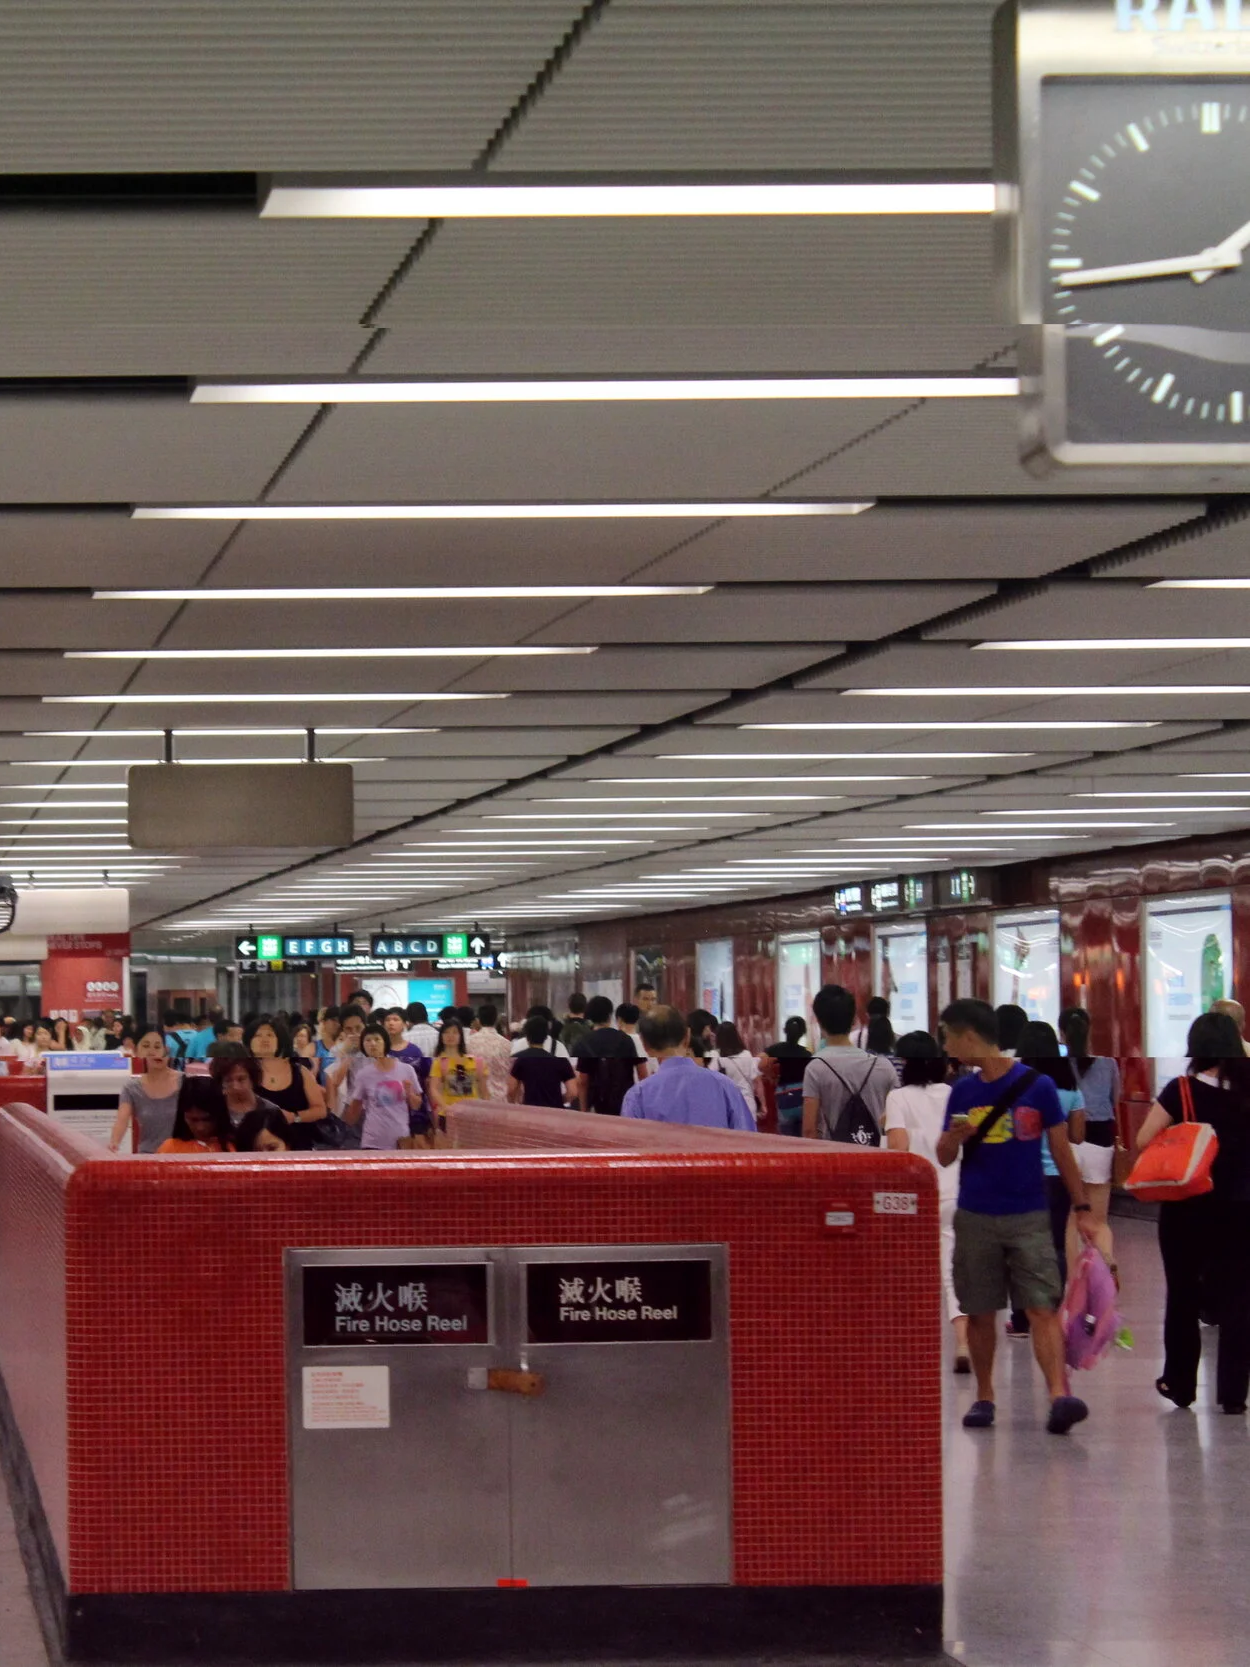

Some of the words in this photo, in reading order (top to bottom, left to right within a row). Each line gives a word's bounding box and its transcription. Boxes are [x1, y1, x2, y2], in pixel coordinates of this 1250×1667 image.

[1115, 0, 1250, 31] RA
[321, 940, 332, 953] G
[337, 940, 349, 953] H
[376, 940, 388, 953] A
[426, 940, 438, 952] D
[559, 1306, 591, 1321] Fire
[595, 1306, 637, 1321] Hose
[641, 1304, 678, 1320] Reel
[335, 1315, 370, 1332] Fire
[374, 1315, 423, 1332] Hose
[427, 1314, 468, 1331] Reel
